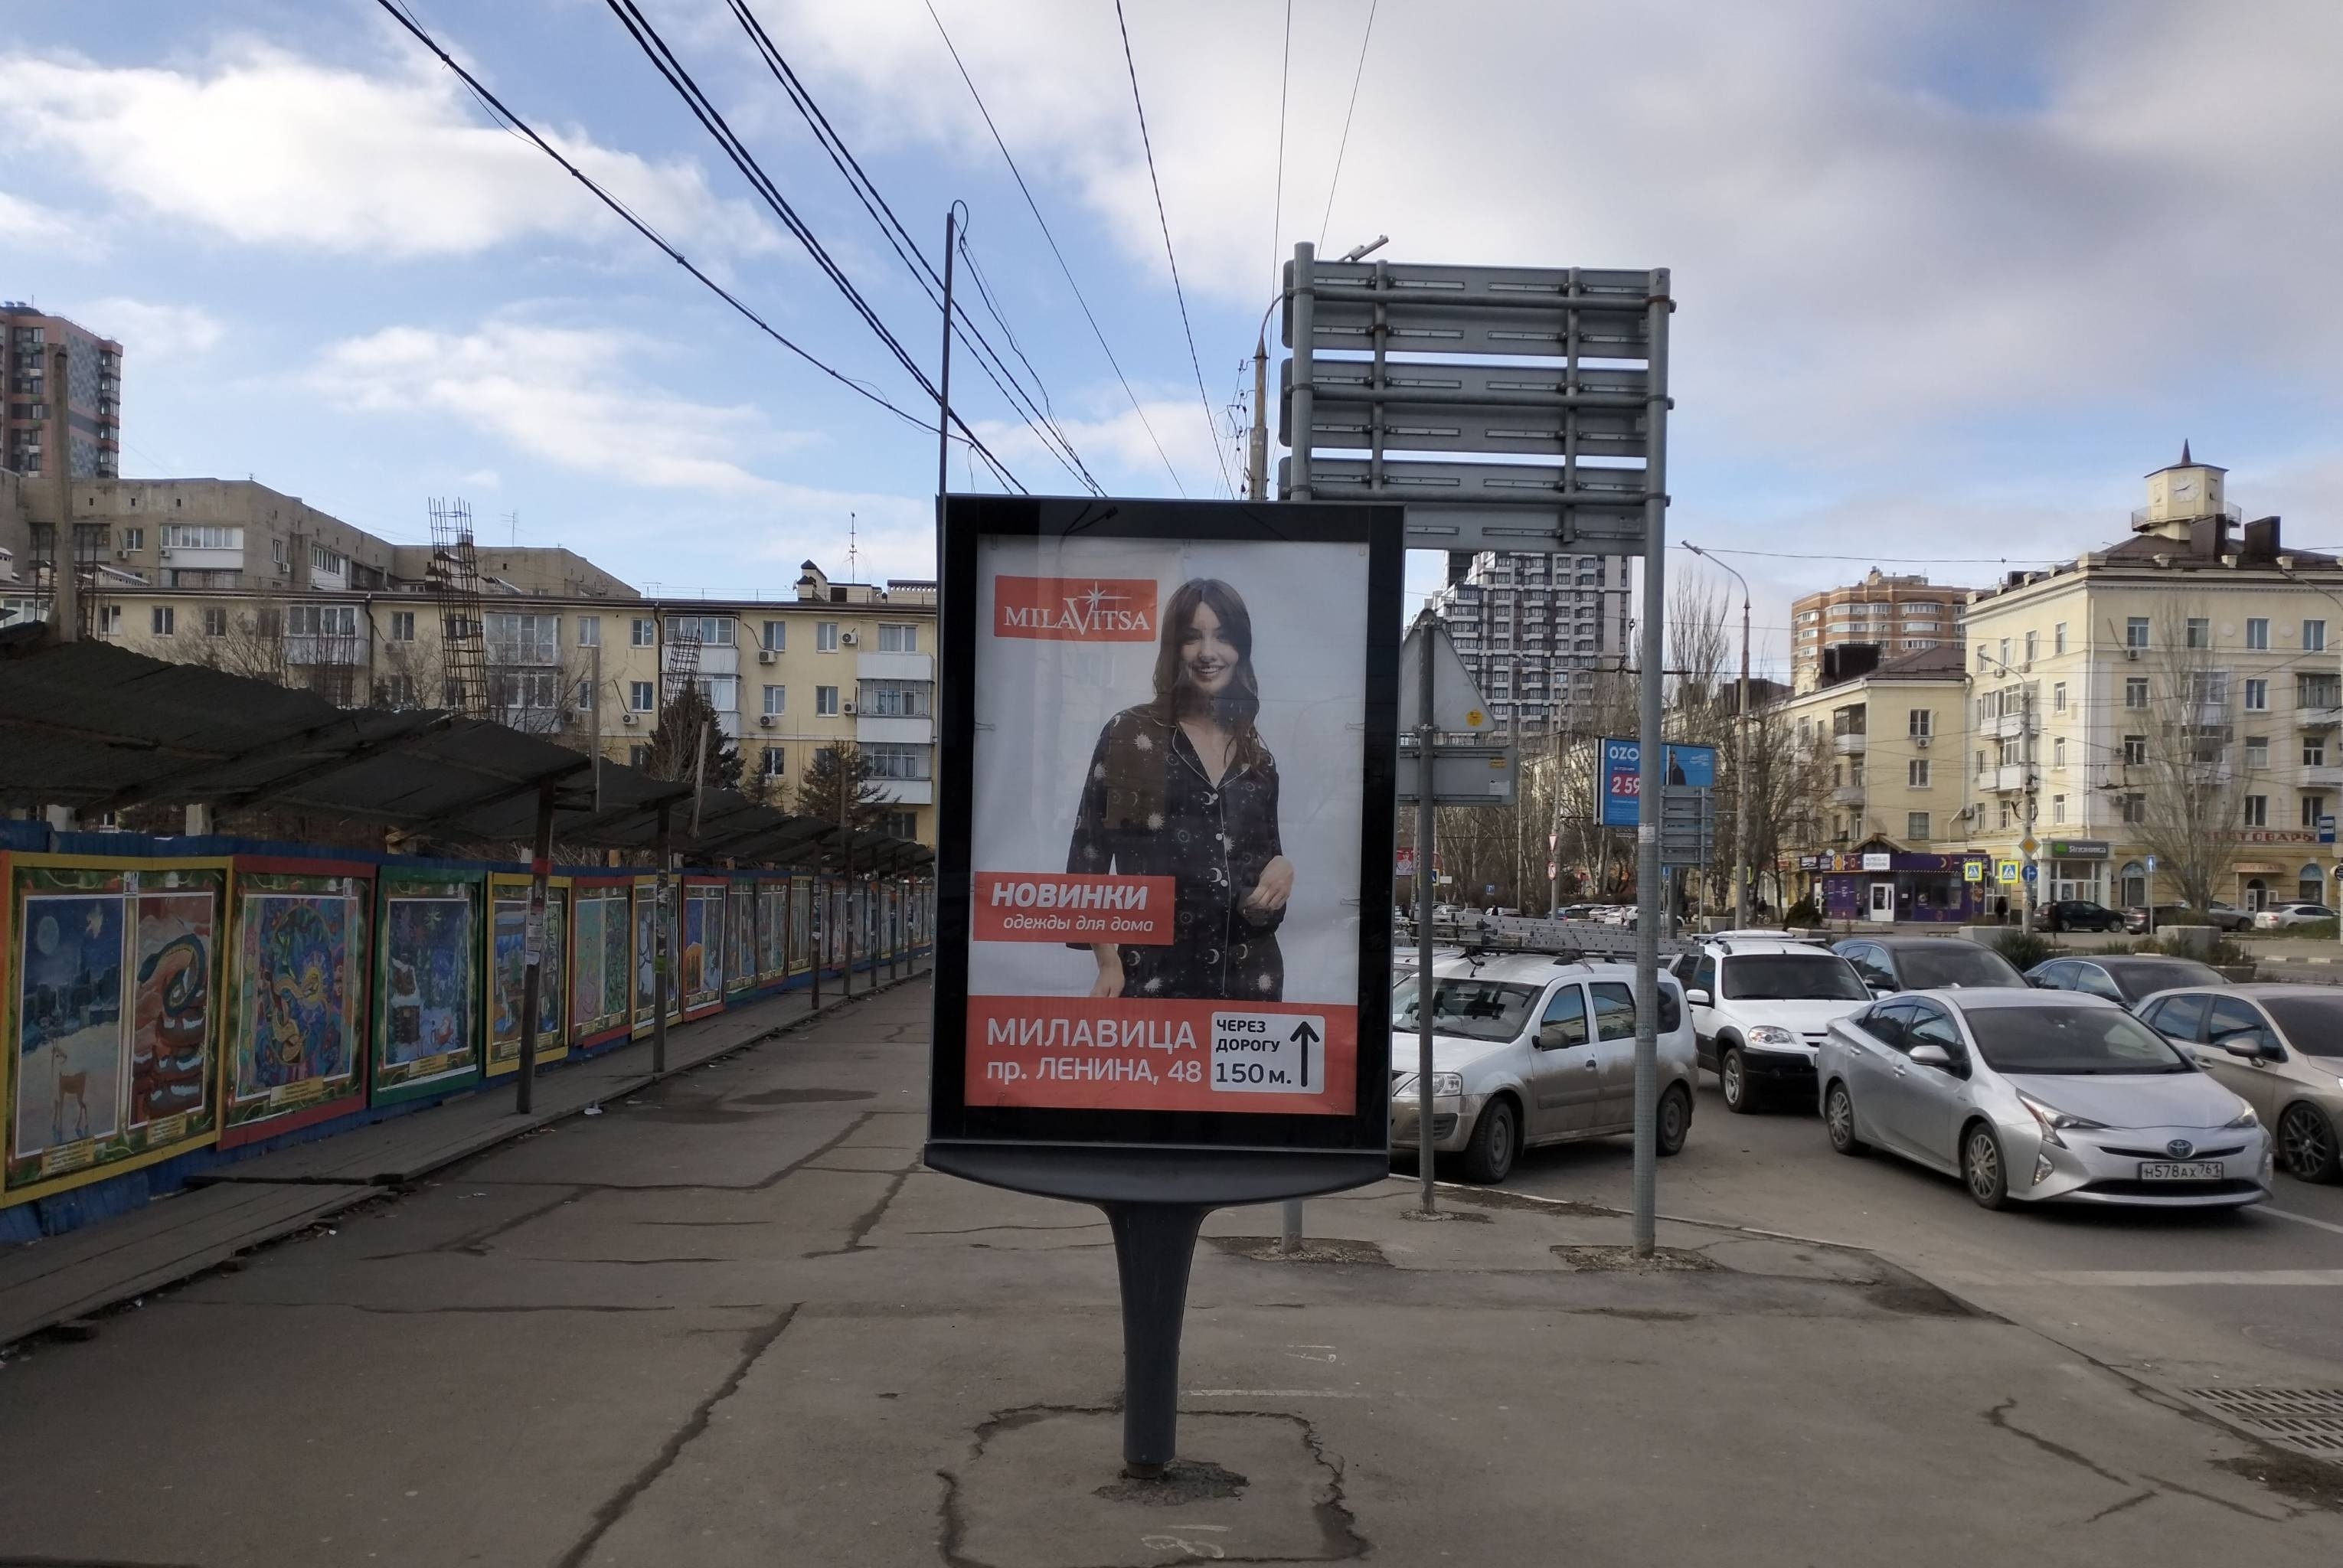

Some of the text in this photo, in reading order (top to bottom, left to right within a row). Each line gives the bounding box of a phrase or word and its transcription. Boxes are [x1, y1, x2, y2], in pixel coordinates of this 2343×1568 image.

[1004, 597, 1151, 635] MILAVITSA
[1609, 746, 1639, 761] OZO
[1624, 777, 1640, 794] 59
[991, 882, 1149, 910] НОВИНКИ
[1003, 914, 1154, 933] одежды для дома
[1216, 1019, 1266, 1033] ЧЕРЕЗ
[987, 1018, 1198, 1055] МИЛАВИЦА
[1215, 1038, 1281, 1054] ДОРОГУ
[987, 1057, 1202, 1086] пр. ЛЕНИНА, 48
[1216, 1063, 1292, 1085] 150 м.
